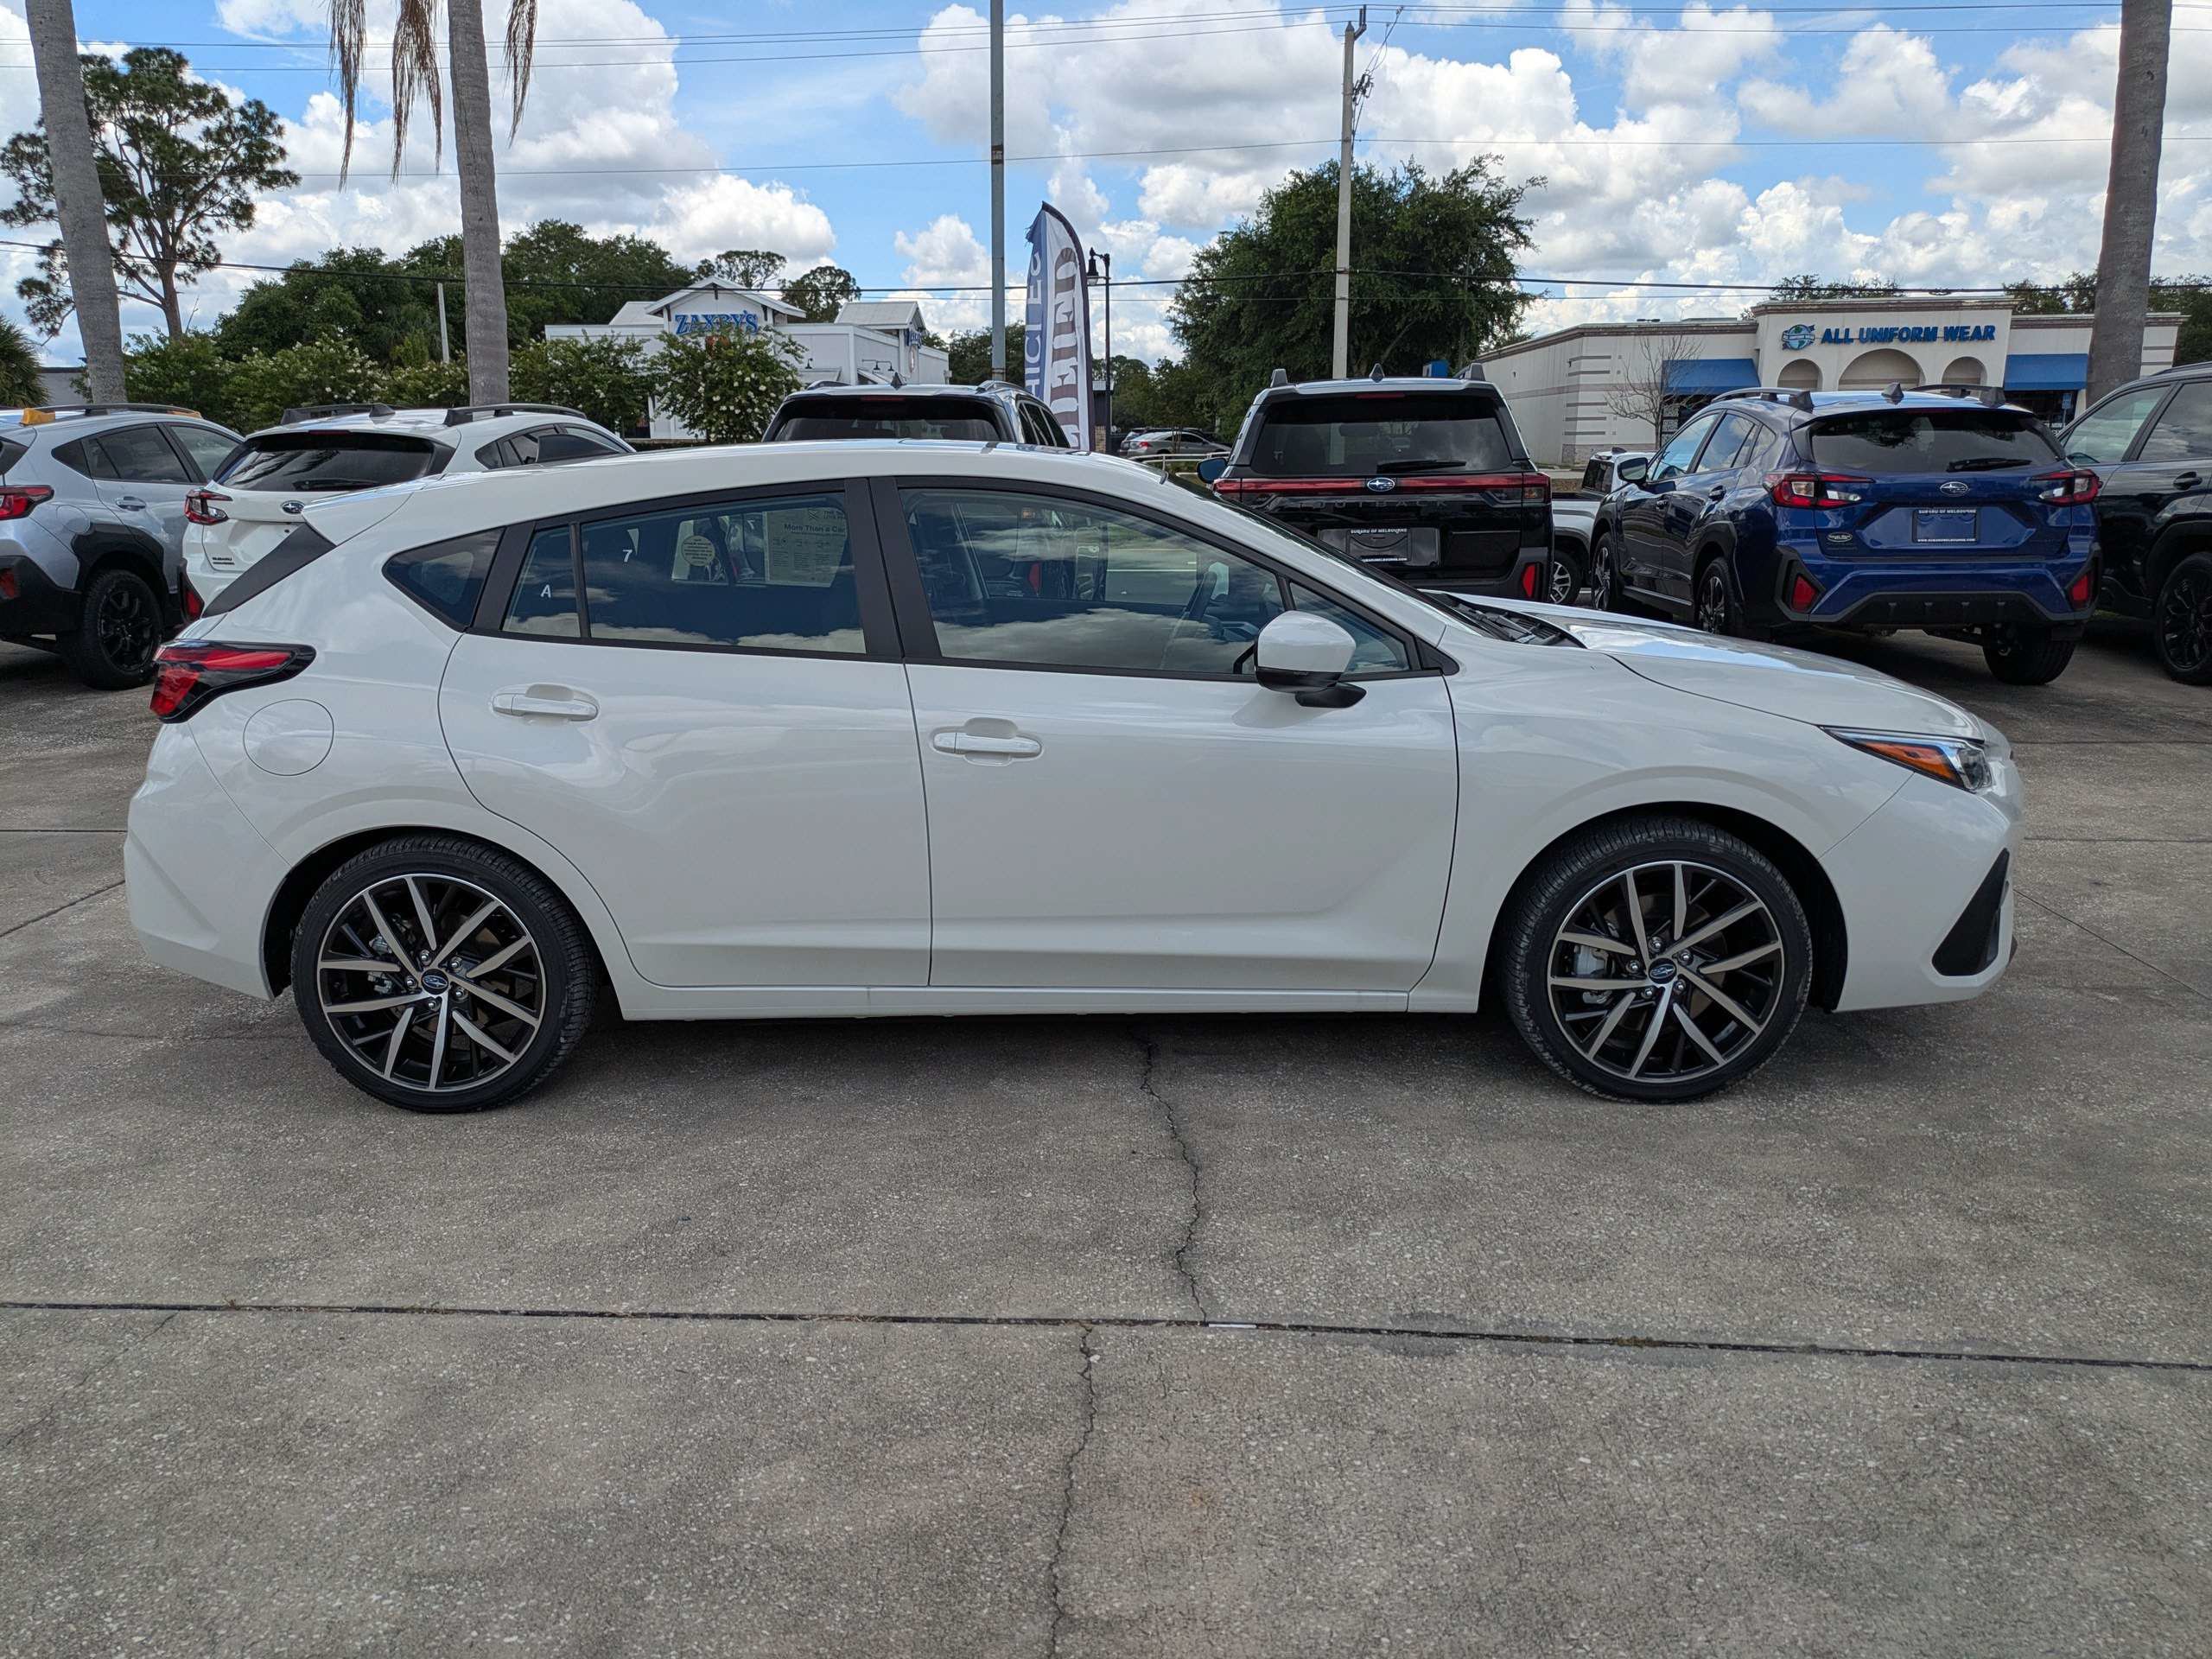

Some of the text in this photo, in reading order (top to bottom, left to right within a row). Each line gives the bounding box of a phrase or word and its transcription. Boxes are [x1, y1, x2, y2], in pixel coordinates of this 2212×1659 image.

[1821, 324, 1996, 344] ALL UNIFORM WEAR
[622, 549, 633, 563] 7
[540, 584, 552, 599] A
